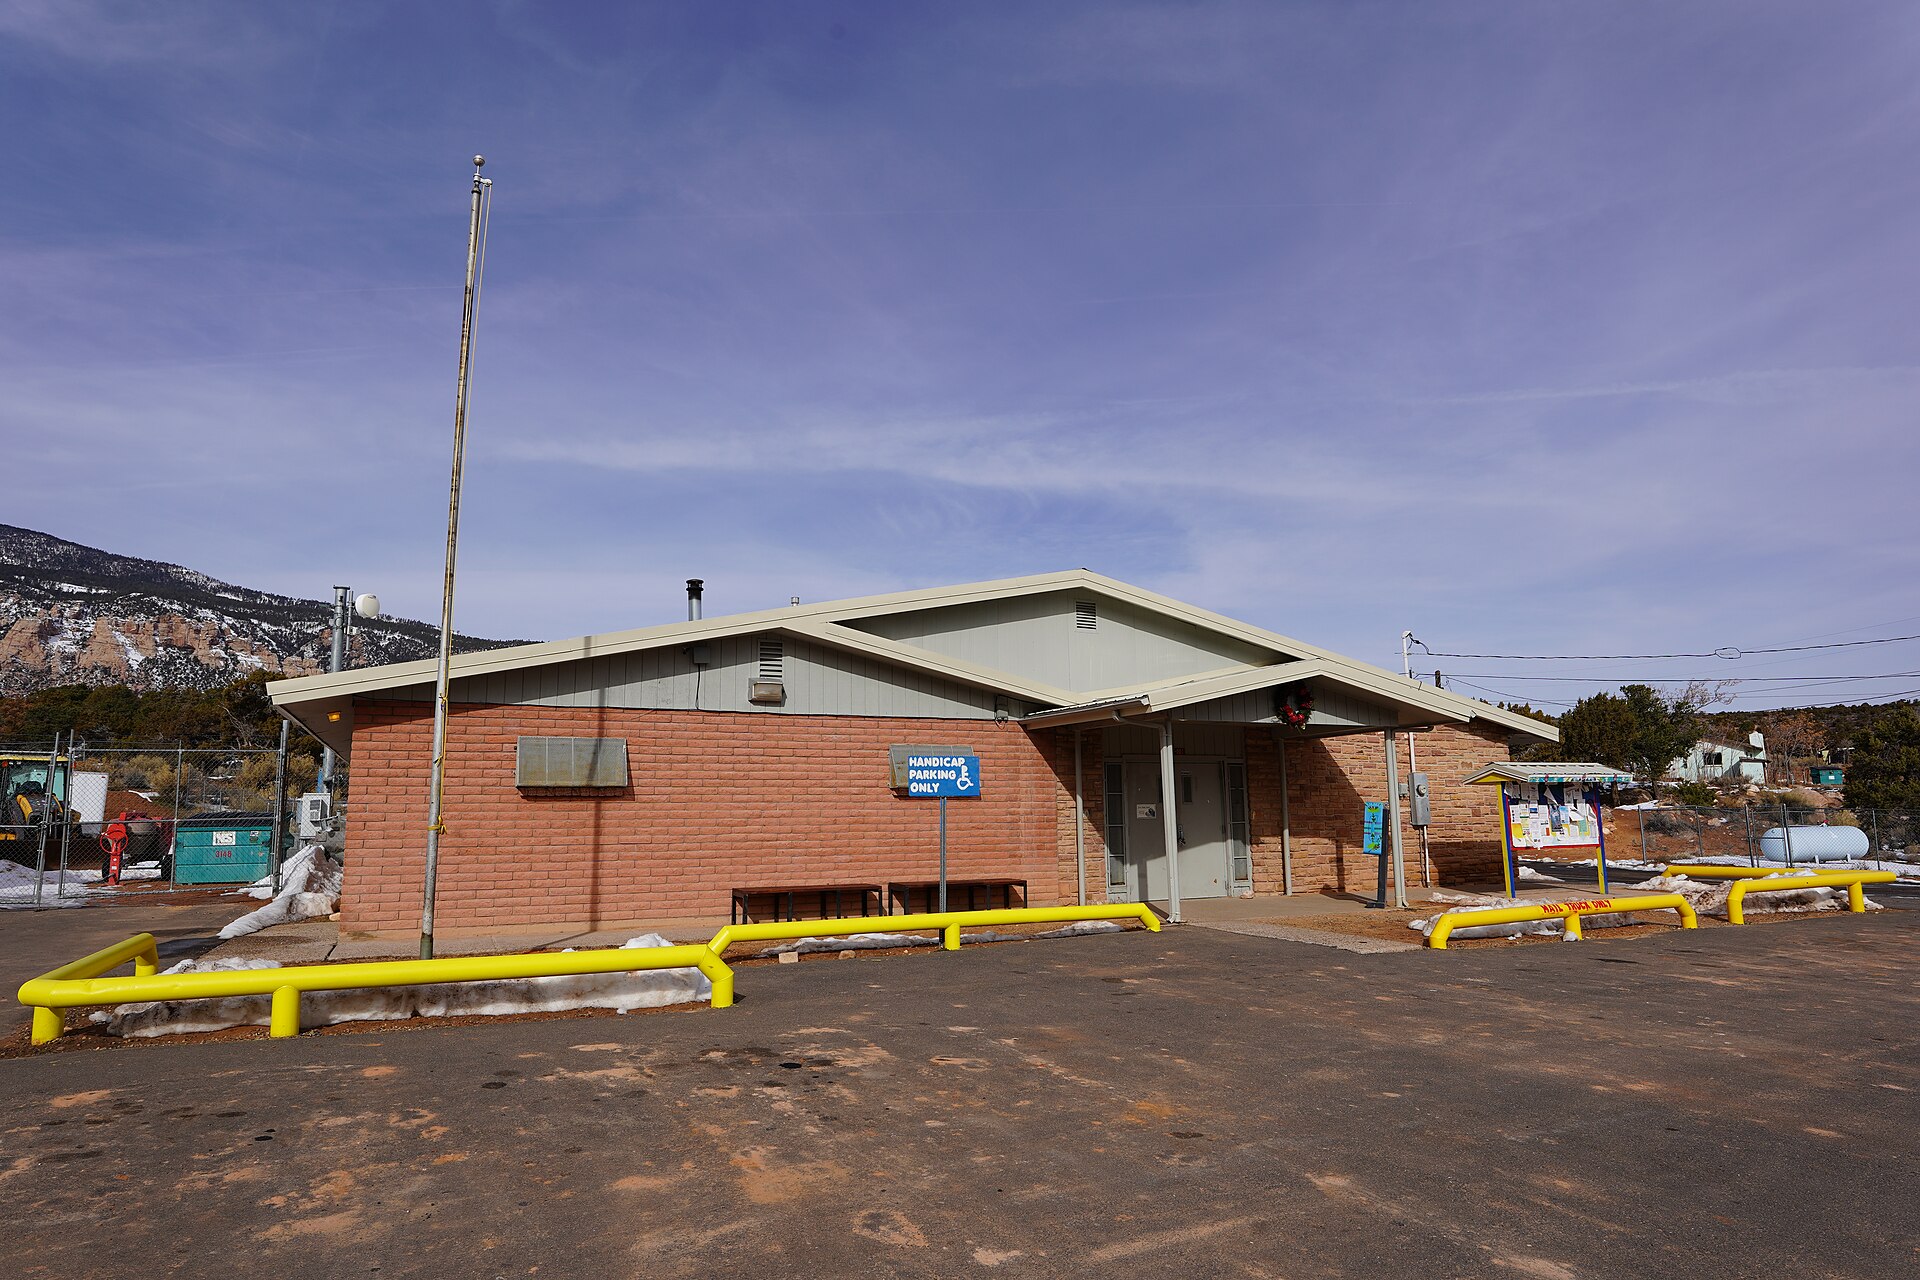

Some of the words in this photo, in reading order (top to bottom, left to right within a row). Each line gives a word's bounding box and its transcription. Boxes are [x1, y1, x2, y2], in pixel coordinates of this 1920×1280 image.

[909, 757, 965, 767] HANDICAP
[909, 770, 956, 780] PARKING
[910, 782, 939, 792] ONLY
[1540, 904, 1563, 913] MAIL
[1564, 901, 1590, 911] TRUCK
[1591, 900, 1611, 908] ONLY
